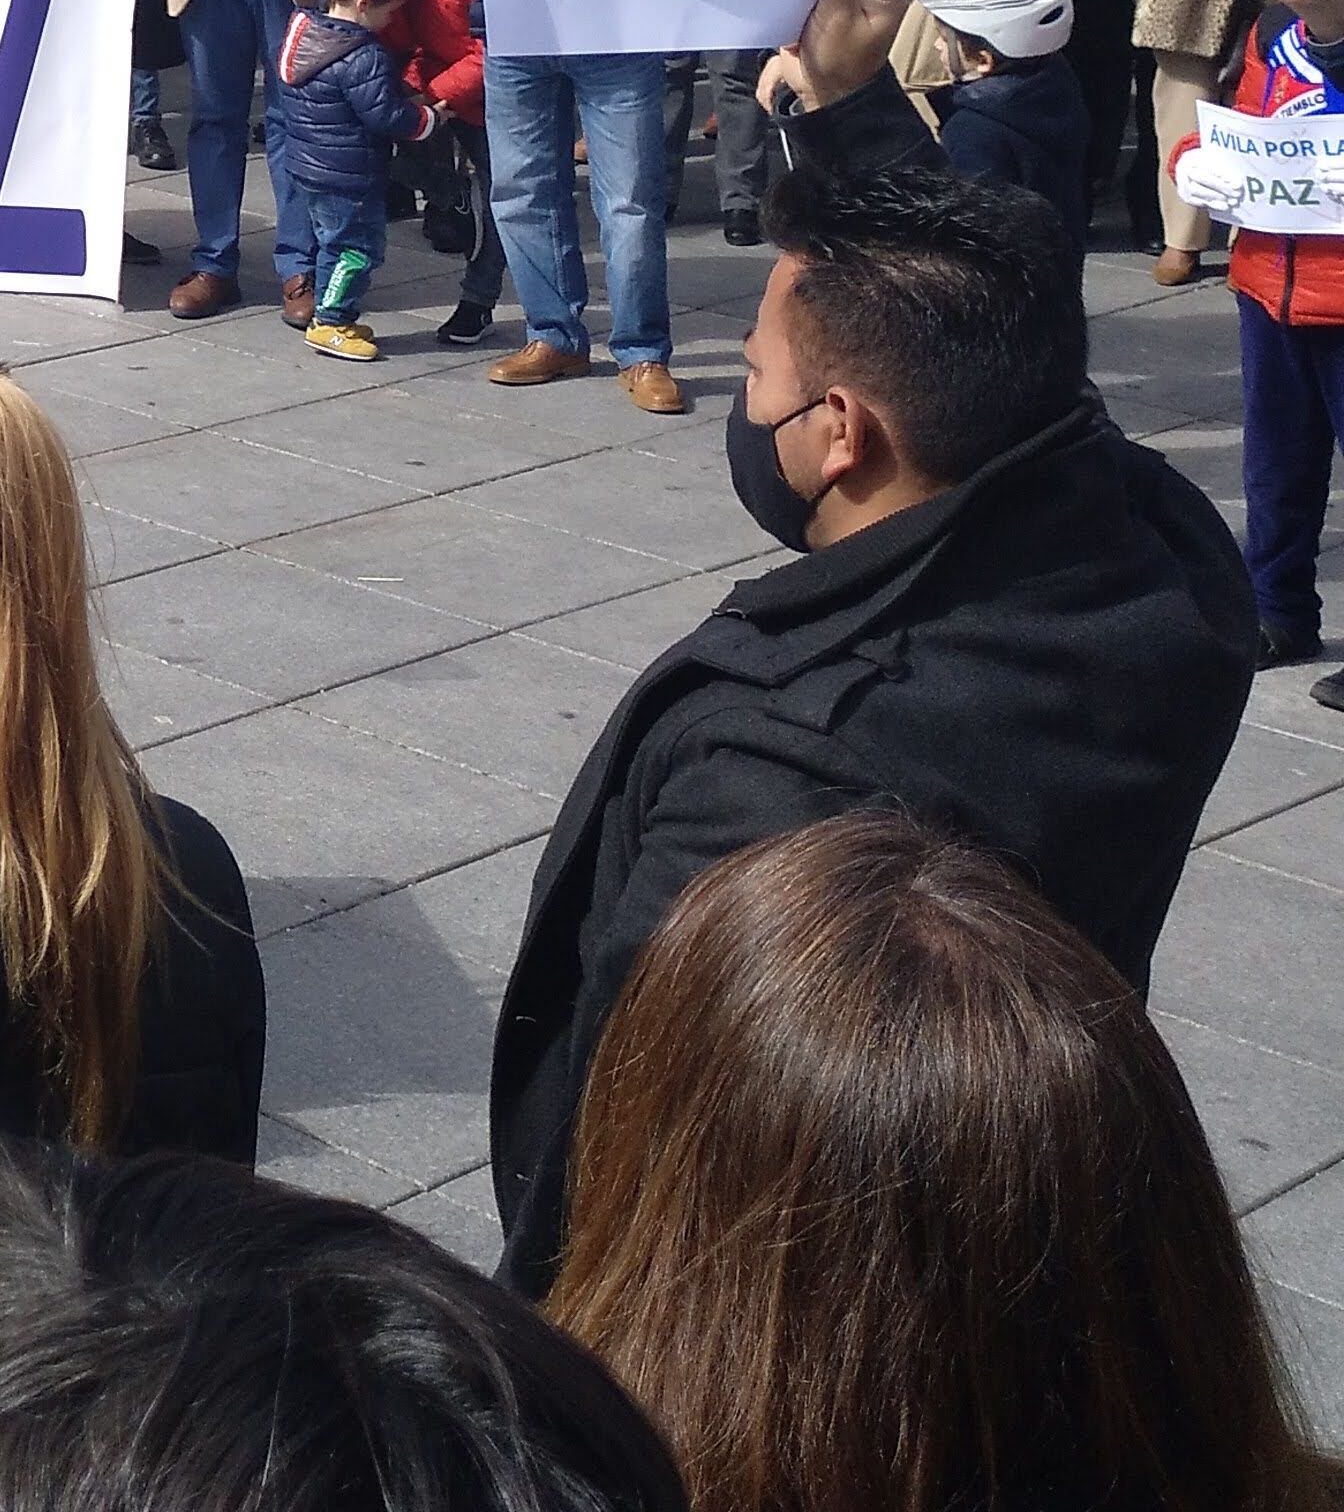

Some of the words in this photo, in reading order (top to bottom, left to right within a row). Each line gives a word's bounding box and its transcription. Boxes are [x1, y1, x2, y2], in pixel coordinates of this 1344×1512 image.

[1210, 124, 1260, 156] ÁVILA
[1264, 140, 1316, 157] POR
[1322, 140, 1344, 157] LA
[1246, 176, 1320, 205] PAZ
